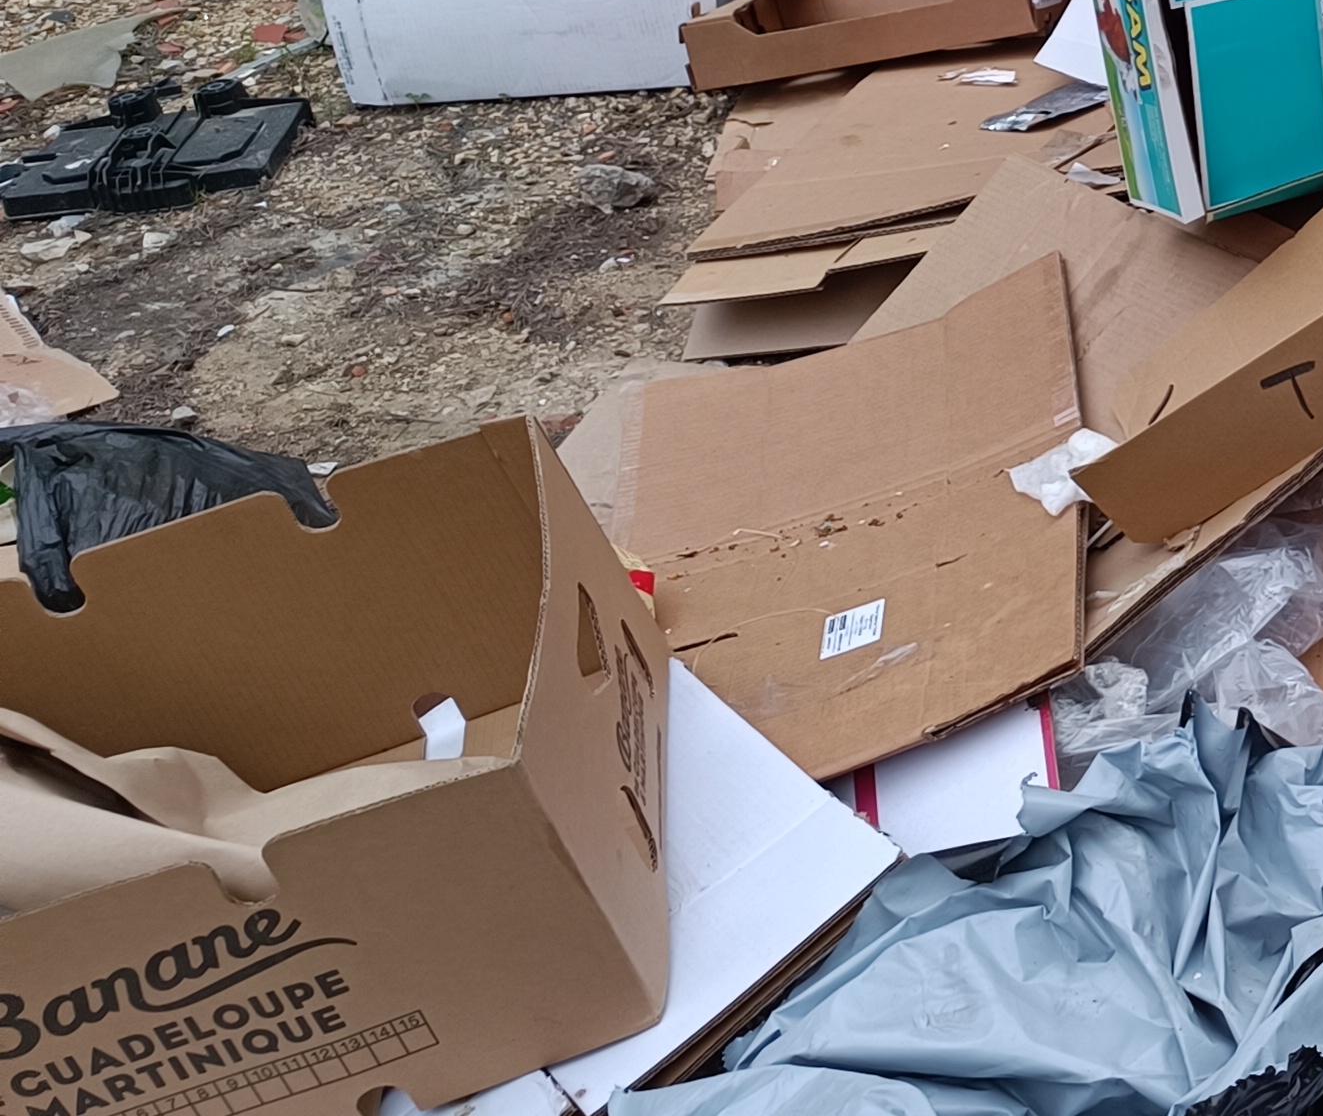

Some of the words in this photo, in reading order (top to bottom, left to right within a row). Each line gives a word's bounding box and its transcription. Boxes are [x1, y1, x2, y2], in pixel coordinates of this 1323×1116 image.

[0, 908, 302, 1060] Banane
[10, 969, 350, 1097] GUADELOUPE
[26, 1005, 347, 1116] MARTINIQUE
[251, 1066, 275, 1082] 10
[281, 1057, 302, 1073] 11
[310, 1047, 334, 1063] 12
[339, 1036, 363, 1053] 13
[368, 1025, 392, 1042] 14
[398, 1014, 422, 1031] 15
